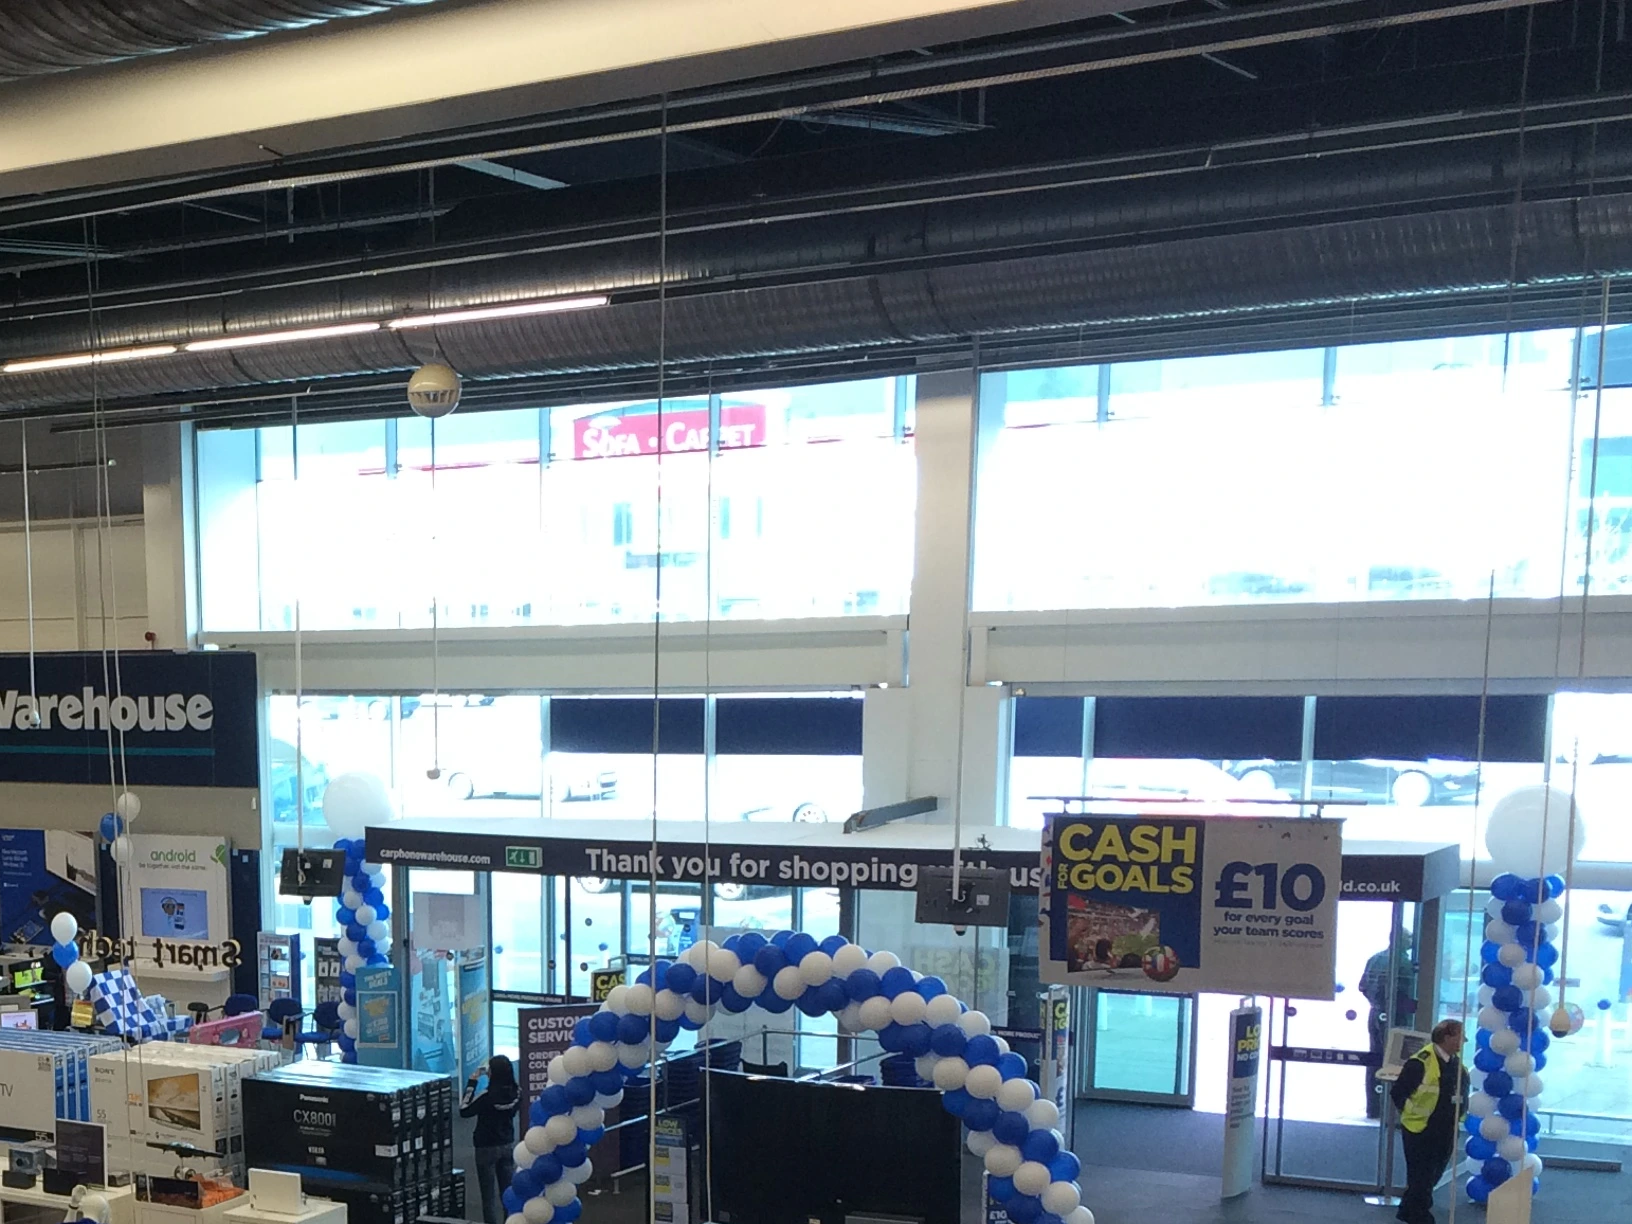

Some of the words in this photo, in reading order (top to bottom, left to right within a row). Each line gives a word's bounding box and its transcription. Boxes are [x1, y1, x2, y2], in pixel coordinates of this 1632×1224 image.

[666, 422, 756, 451] CARET
[1059, 823, 1197, 864] CASH
[150, 848, 196, 863] android
[379, 848, 491, 865] carphonewarehouse.com
[585, 848, 664, 875] Thank
[672, 856, 721, 880] you
[729, 852, 771, 878] for
[778, 855, 919, 888] shopping
[1057, 864, 1068, 889] FOR
[1070, 863, 1195, 895] GOALS
[1214, 861, 1327, 912] £10
[1339, 879, 1401, 894] ld.co.uk
[1224, 911, 1244, 924] for
[1245, 914, 1280, 928] every
[1284, 913, 1314, 928] goal
[1213, 924, 1242, 937] your
[1245, 924, 1279, 938] team
[1282, 927, 1325, 940] scores
[94, 1067, 116, 1076] SONY
[989, 1210, 1007, 1221] £10
